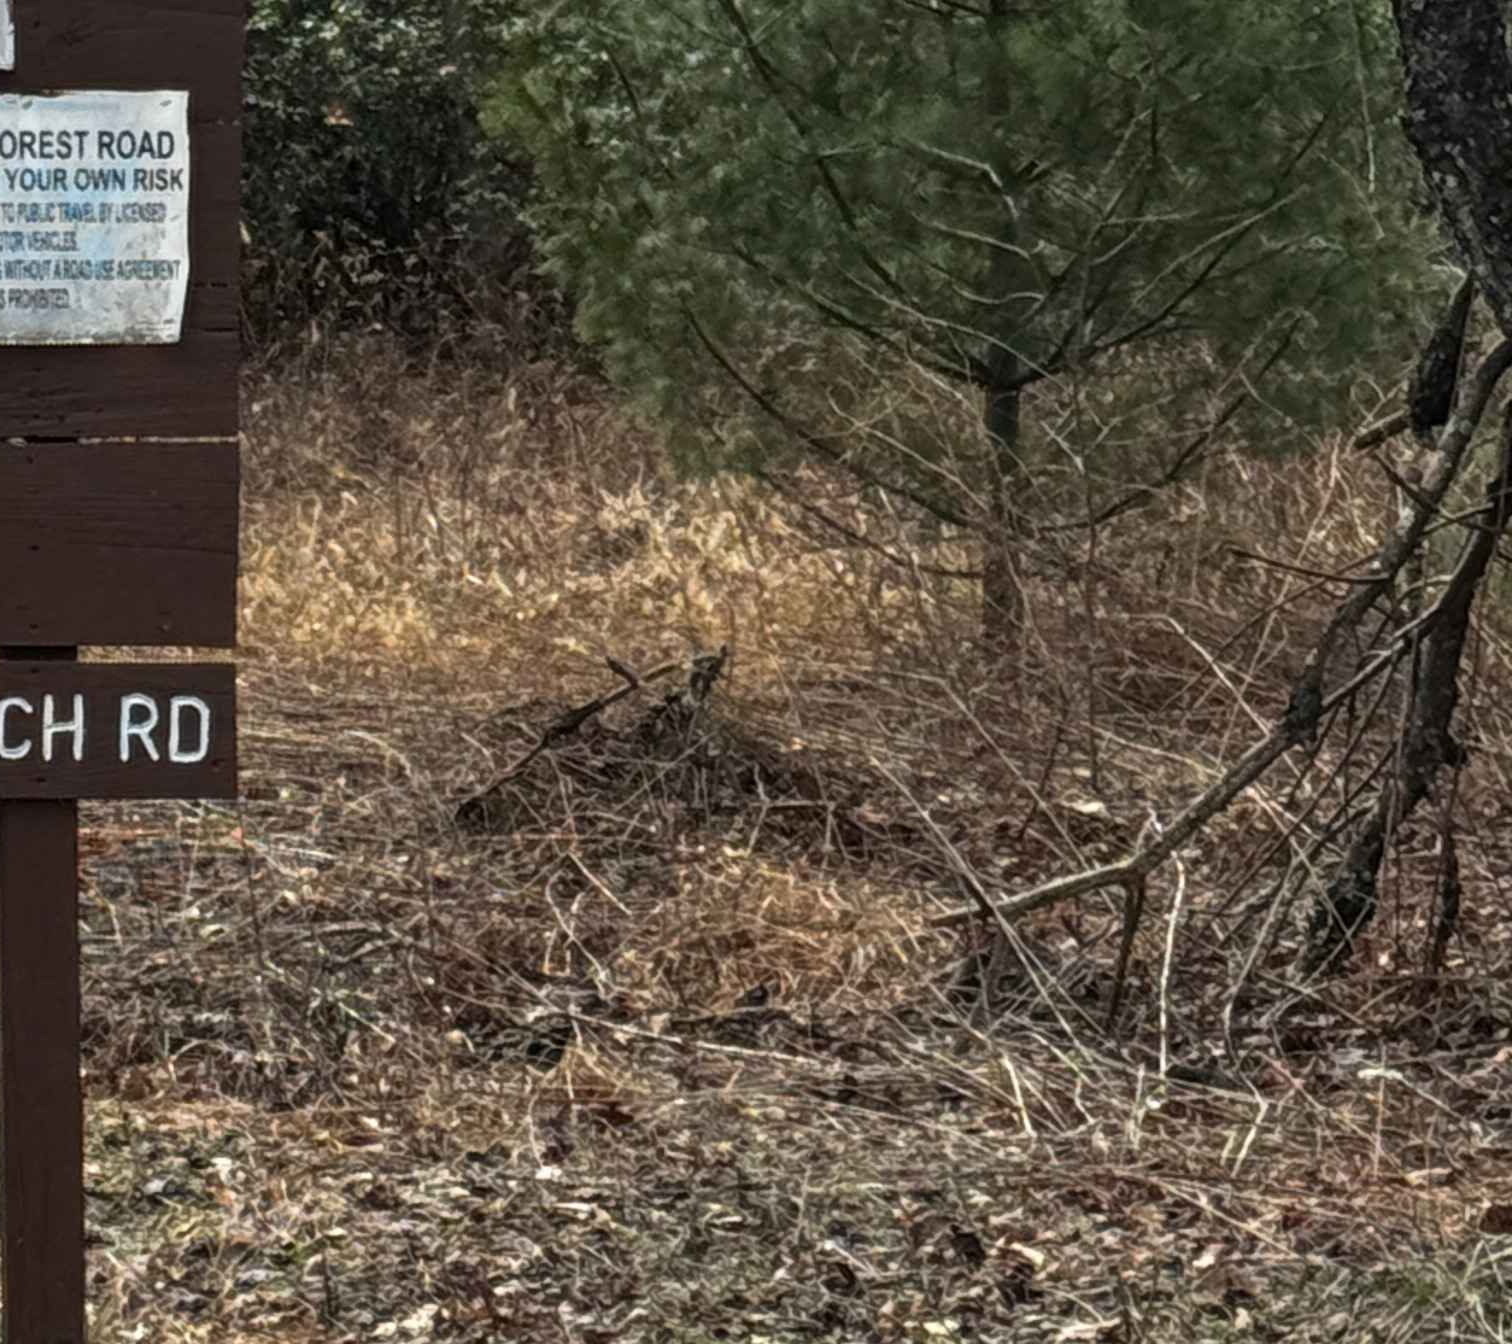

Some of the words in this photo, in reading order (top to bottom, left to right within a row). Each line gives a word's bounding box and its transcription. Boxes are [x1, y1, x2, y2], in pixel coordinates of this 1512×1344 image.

[97, 130, 175, 159] ROAD
[4, 168, 68, 192] YOUR
[73, 168, 126, 191] OWN
[133, 168, 185, 191] RISK
[0, 202, 15, 224] TO
[17, 202, 56, 224] PUBLIC
[57, 202, 97, 224] TRAVEL
[98, 202, 113, 224] BY
[115, 202, 167, 224] LICENSED
[4, 259, 52, 281] WITHOUT
[53, 259, 64, 280] A
[64, 259, 93, 281] ROAD
[94, 259, 115, 281] USE
[116, 259, 181, 281] AGREEMENT
[118, 693, 212, 764] RD
